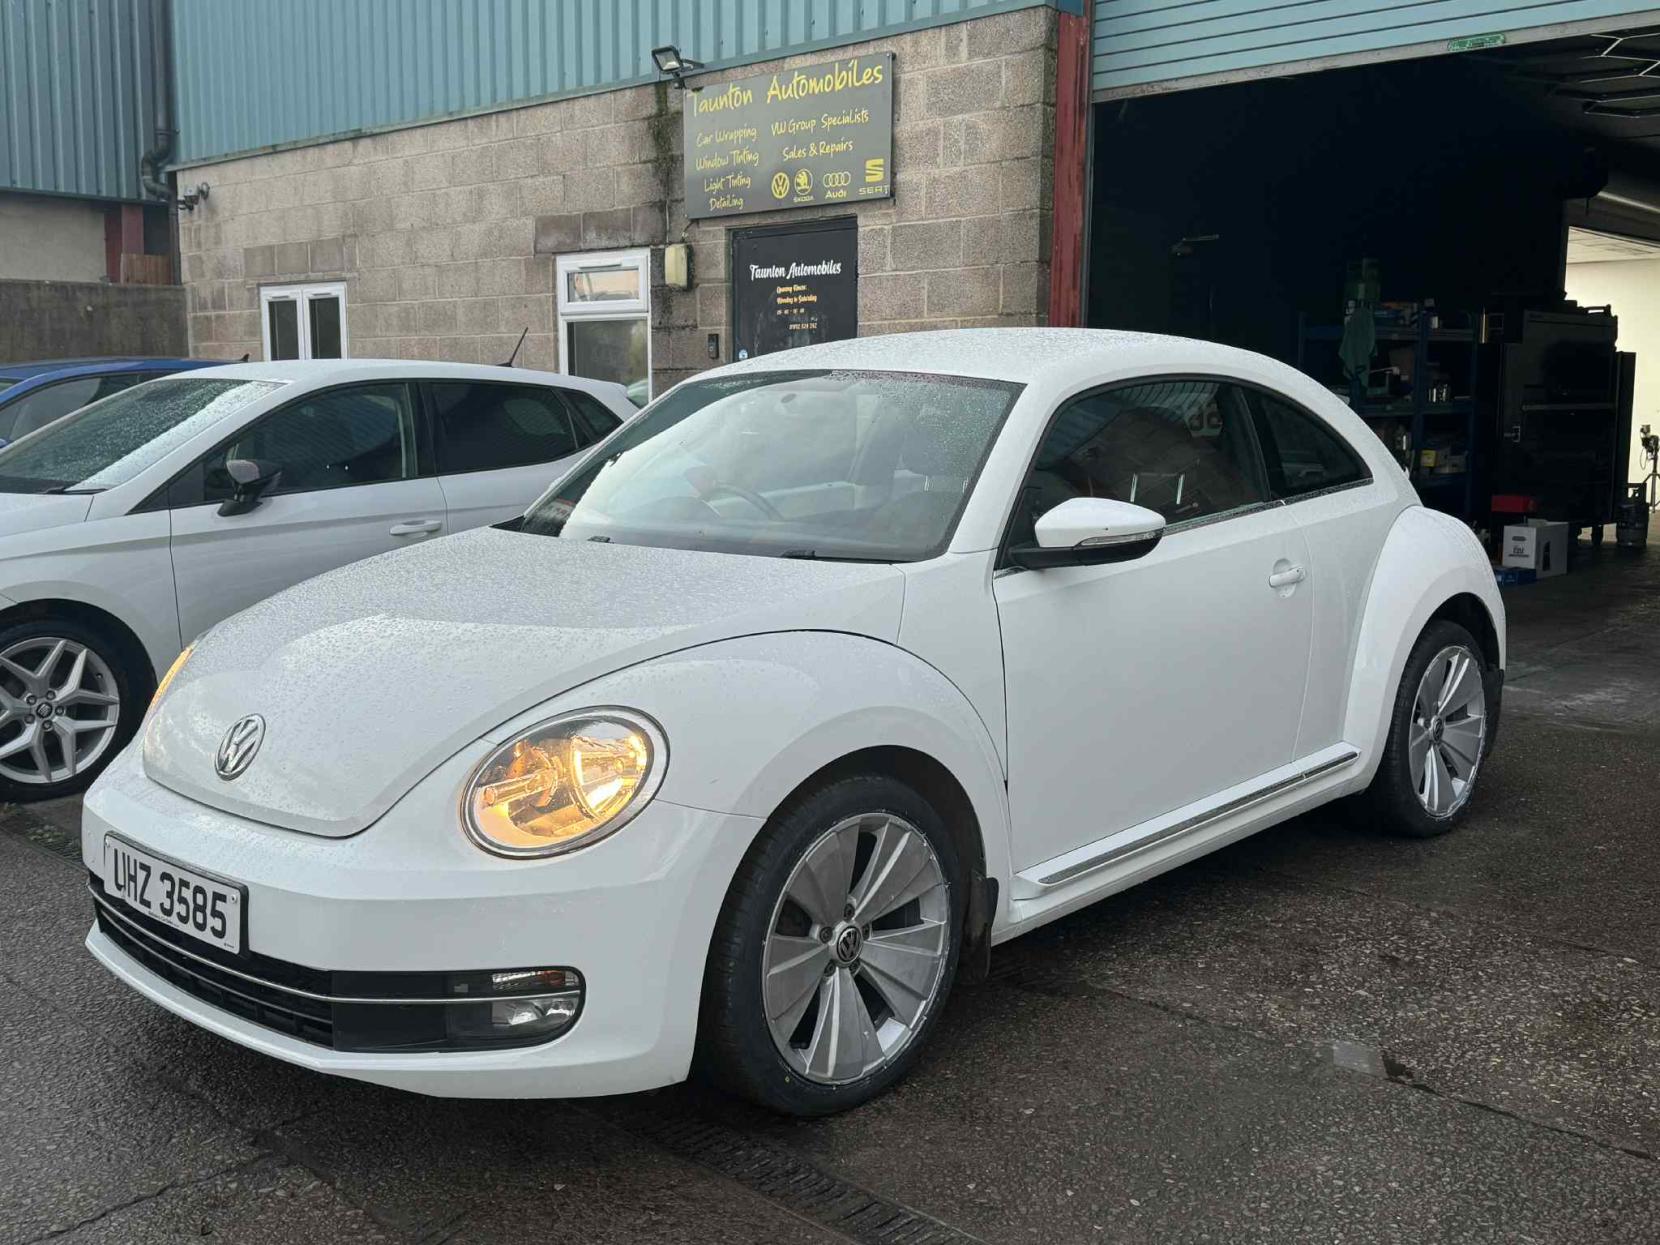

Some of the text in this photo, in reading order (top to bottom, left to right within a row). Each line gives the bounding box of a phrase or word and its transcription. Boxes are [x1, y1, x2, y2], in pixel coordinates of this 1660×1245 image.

[686, 59, 883, 117] Taunton Automobiles
[771, 108, 870, 137] VW Group Specialists
[696, 123, 757, 148] Car Wrapping
[695, 146, 760, 171] Window Tinting
[782, 137, 854, 161] Sales & Repairs
[704, 171, 751, 195] Light Tinting
[825, 189, 847, 200] Audi
[858, 185, 889, 195] SEAT
[709, 194, 744, 211] Detailing
[749, 260, 842, 281] Taunton Automobiles
[114, 848, 228, 940] UHZ 3585
